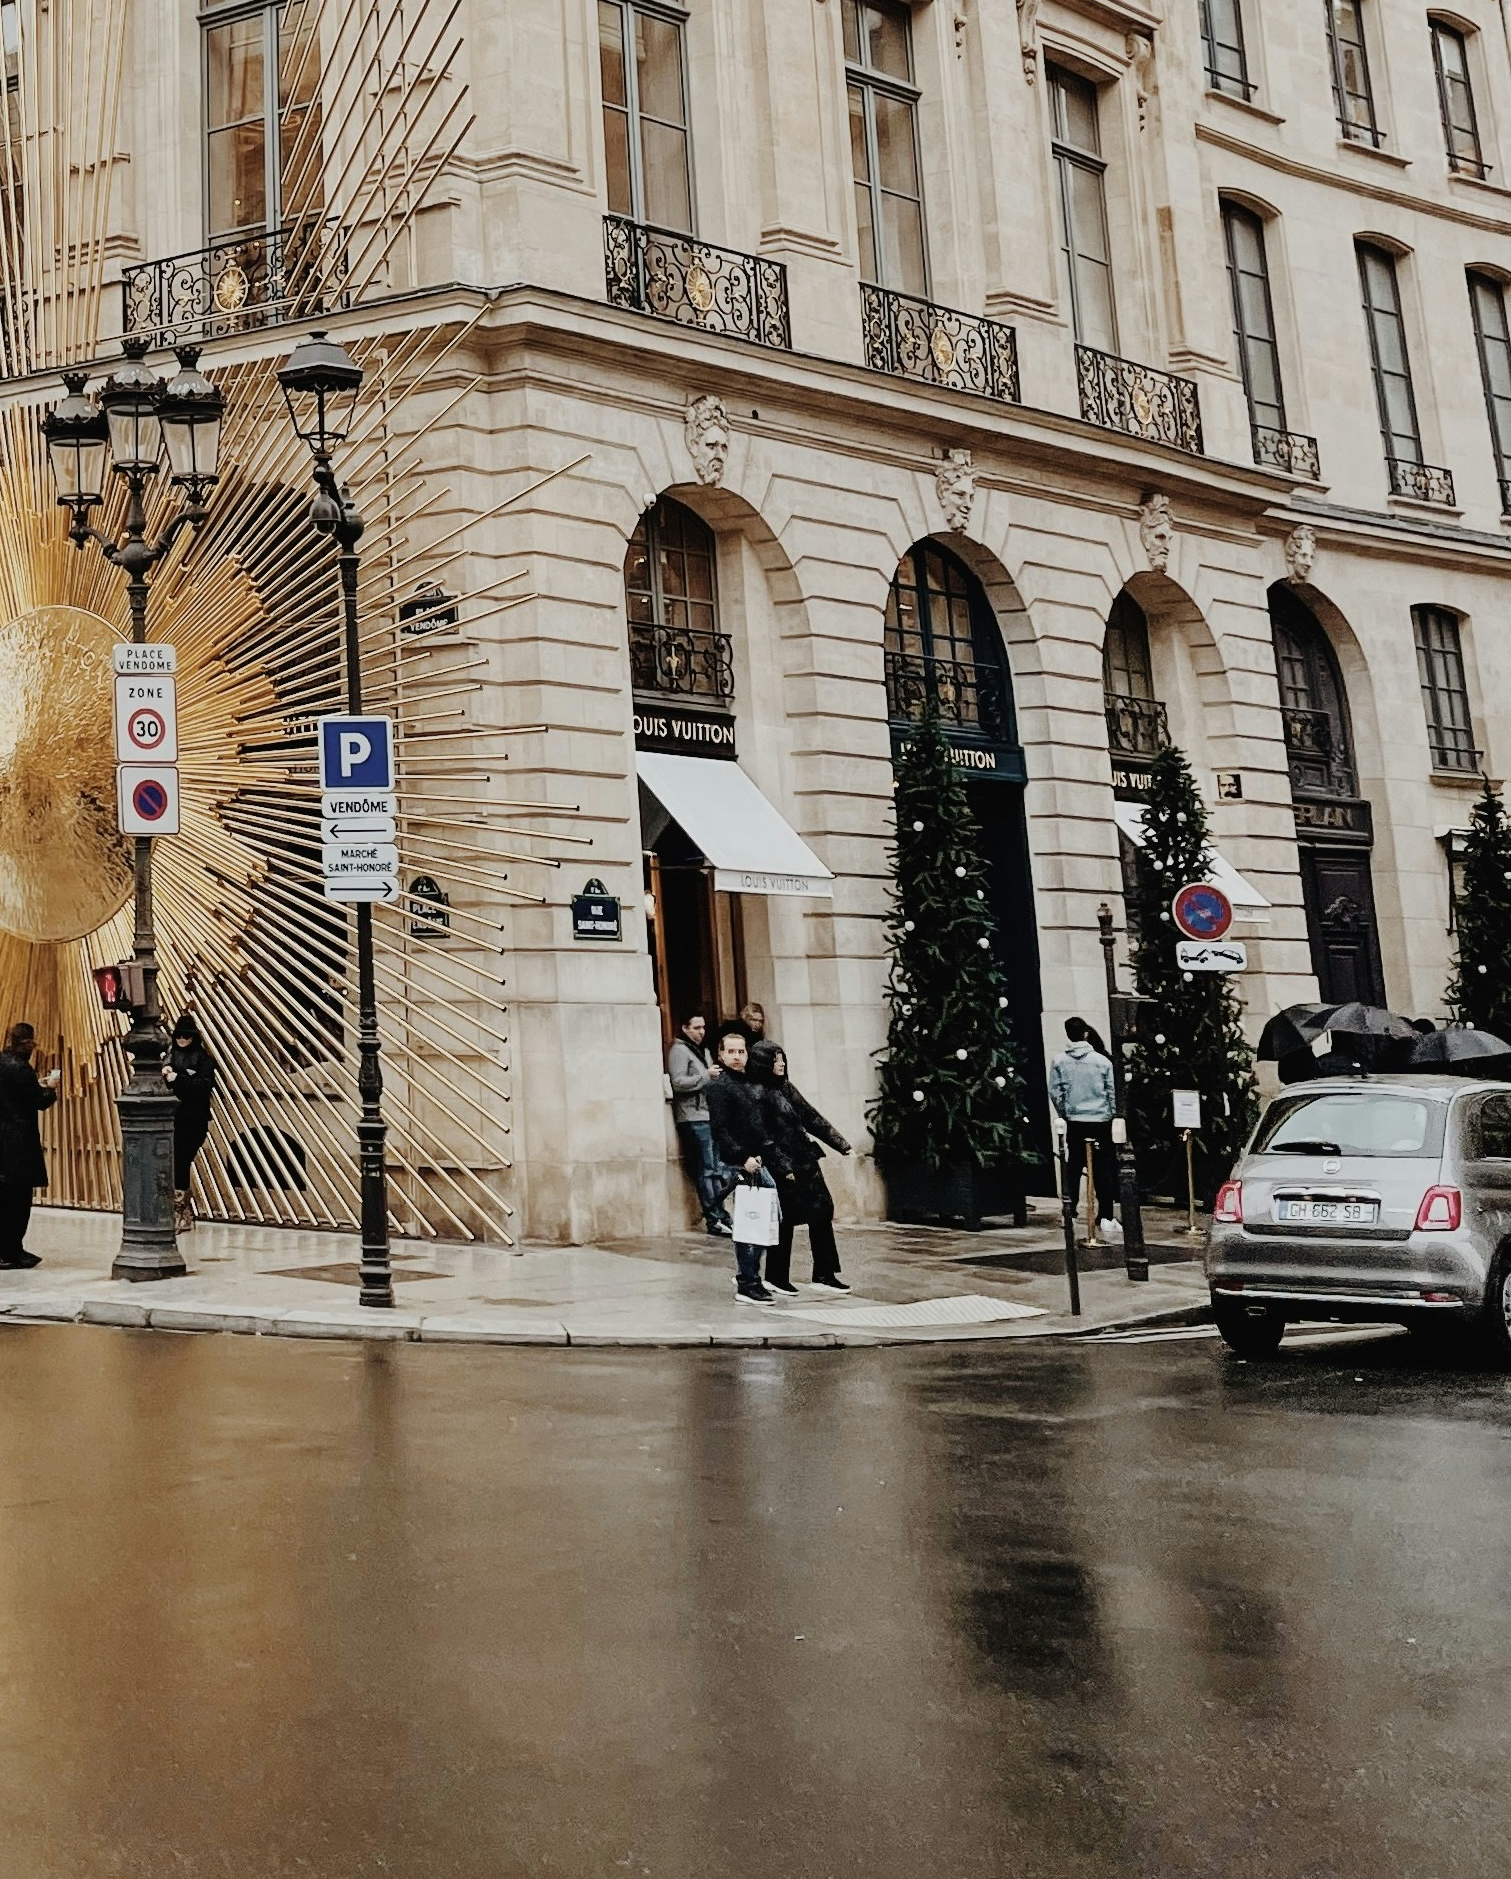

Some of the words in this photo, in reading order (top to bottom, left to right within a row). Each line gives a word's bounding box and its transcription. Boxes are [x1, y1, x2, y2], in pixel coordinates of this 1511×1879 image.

[127, 649, 164, 659] PLACE
[119, 661, 172, 670] VENDOME
[129, 688, 164, 698] ZONE
[136, 720, 159, 738] 30
[634, 715, 668, 737] OUIS
[672, 719, 734, 744] VUITTON
[339, 732, 372, 778] P
[330, 798, 389, 814] VENDÔME
[341, 848, 378, 858] MARCHÉ
[328, 862, 392, 872] SAINT-HONORÉ
[741, 874, 767, 889] LOUIS
[769, 877, 809, 891] VUITTON
